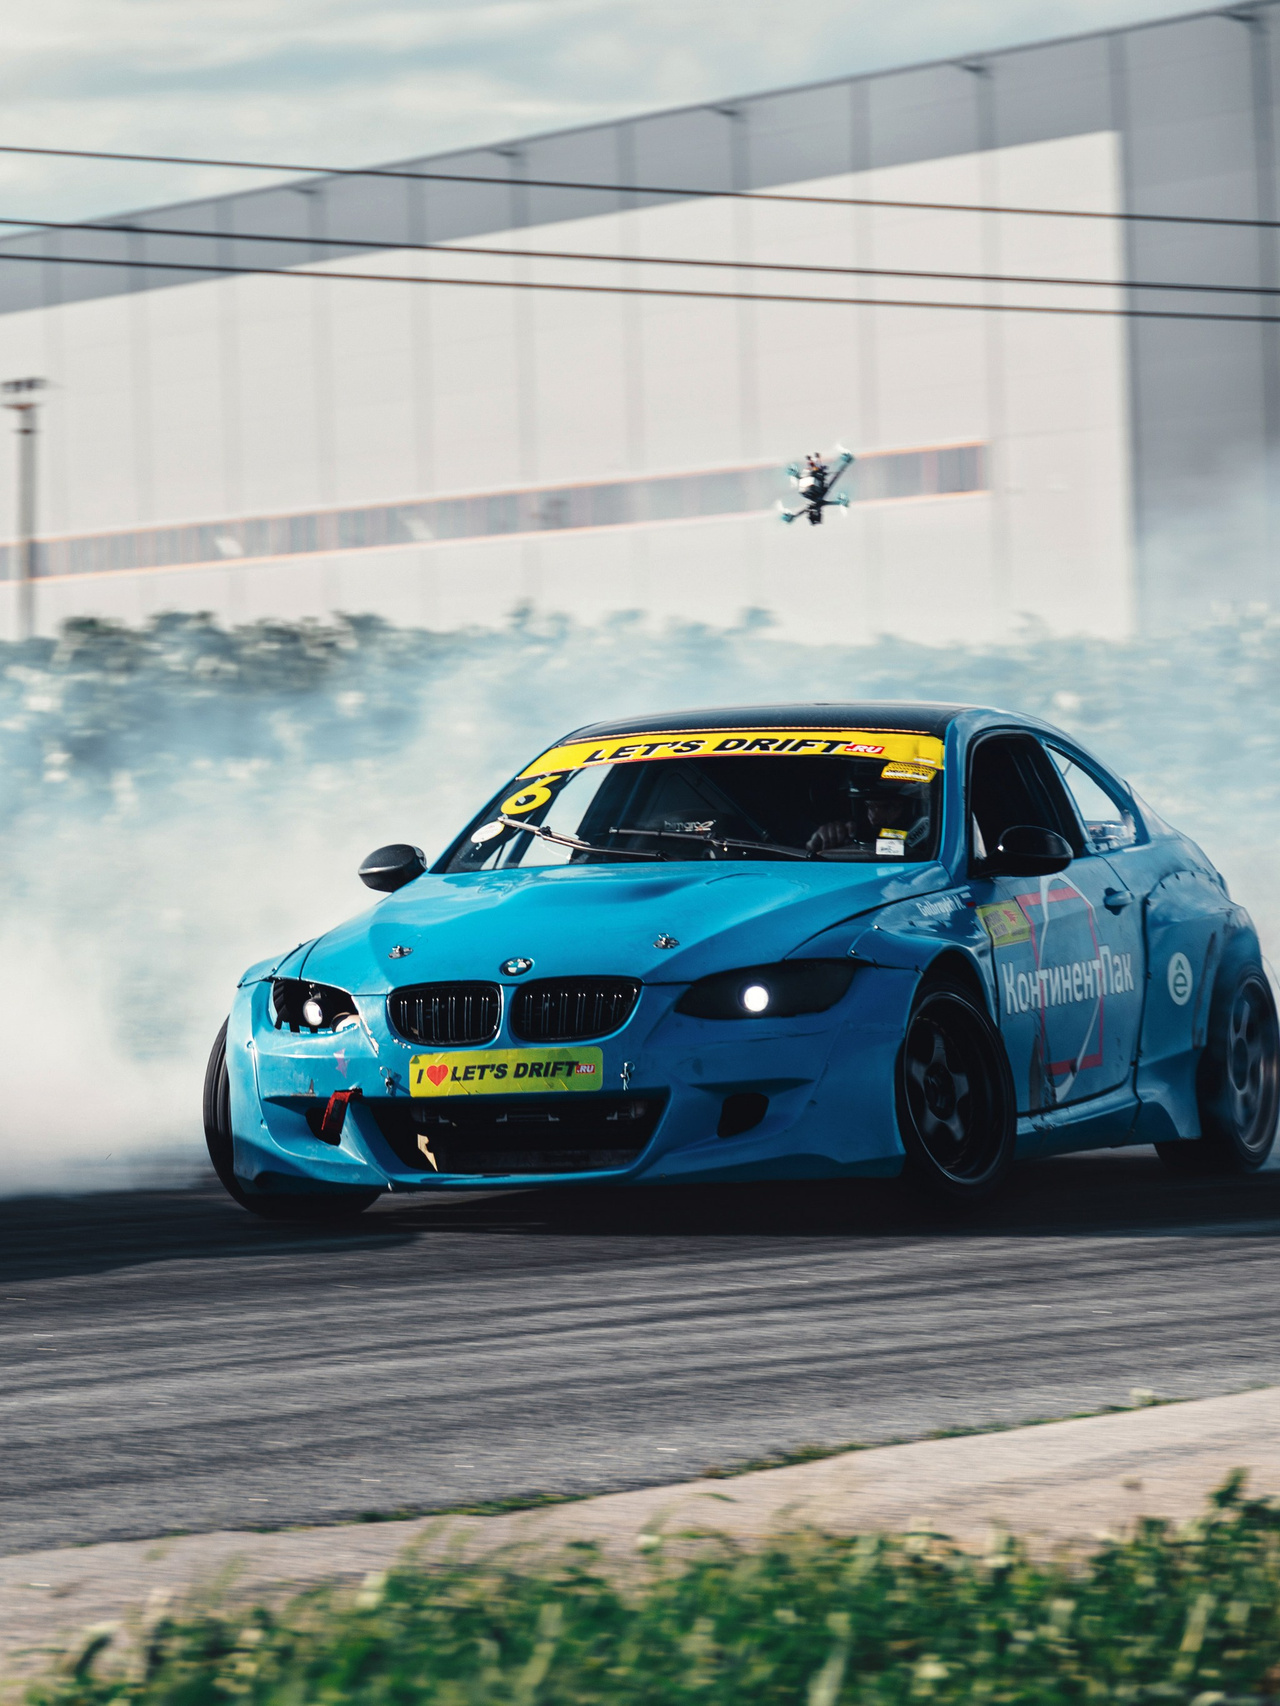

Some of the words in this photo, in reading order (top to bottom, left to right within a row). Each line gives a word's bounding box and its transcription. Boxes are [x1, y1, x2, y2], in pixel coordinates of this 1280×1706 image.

[583, 740, 708, 763] LET'S
[500, 775, 562, 815] 6
[1001, 944, 1134, 1015] КонтинентПак
[416, 1069, 424, 1084] I
[450, 1063, 508, 1082] LET'S
